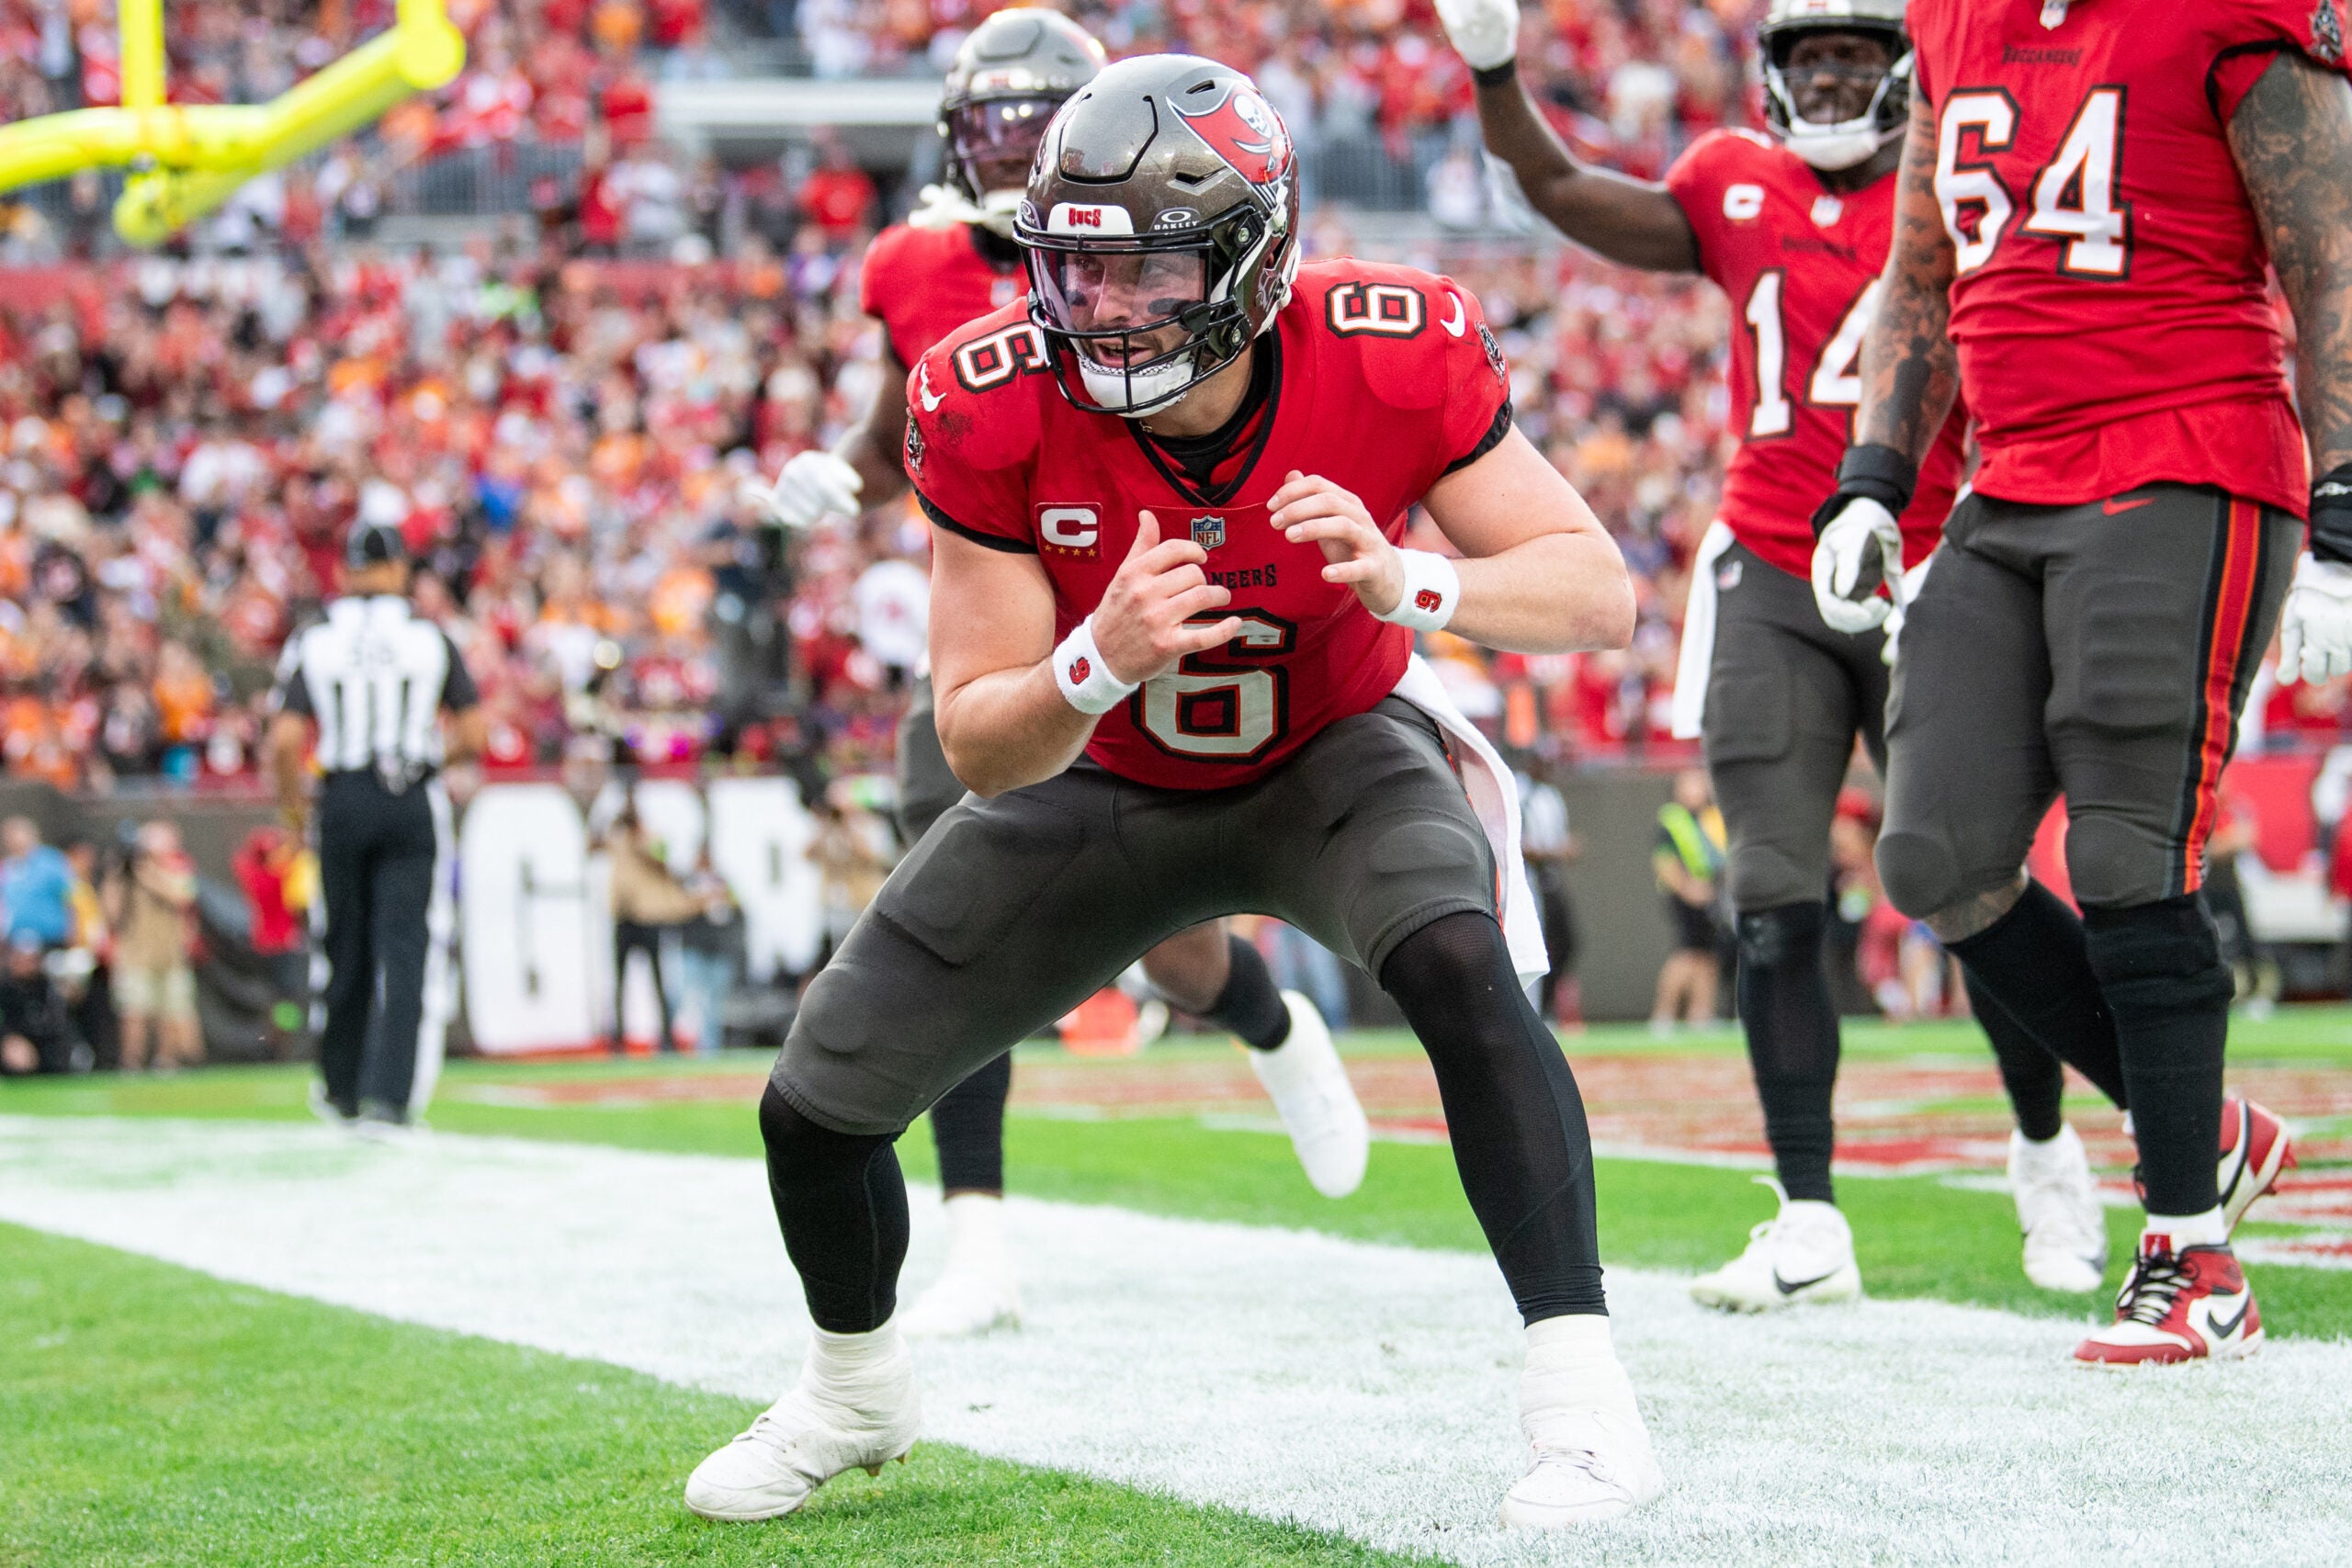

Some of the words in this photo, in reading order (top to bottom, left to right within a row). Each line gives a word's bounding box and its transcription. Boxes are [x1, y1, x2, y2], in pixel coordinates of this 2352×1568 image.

[1723, 184, 1765, 220] C
[1933, 84, 2134, 283] 64
[1153, 220, 1199, 231] OAKLEY
[1325, 280, 1427, 341] 6
[1744, 266, 1881, 446] 14
[1040, 508, 1098, 547] C
[1195, 530, 1221, 546] NFL
[1205, 563, 1278, 591] NEERS
[1130, 607, 1298, 766] 6
